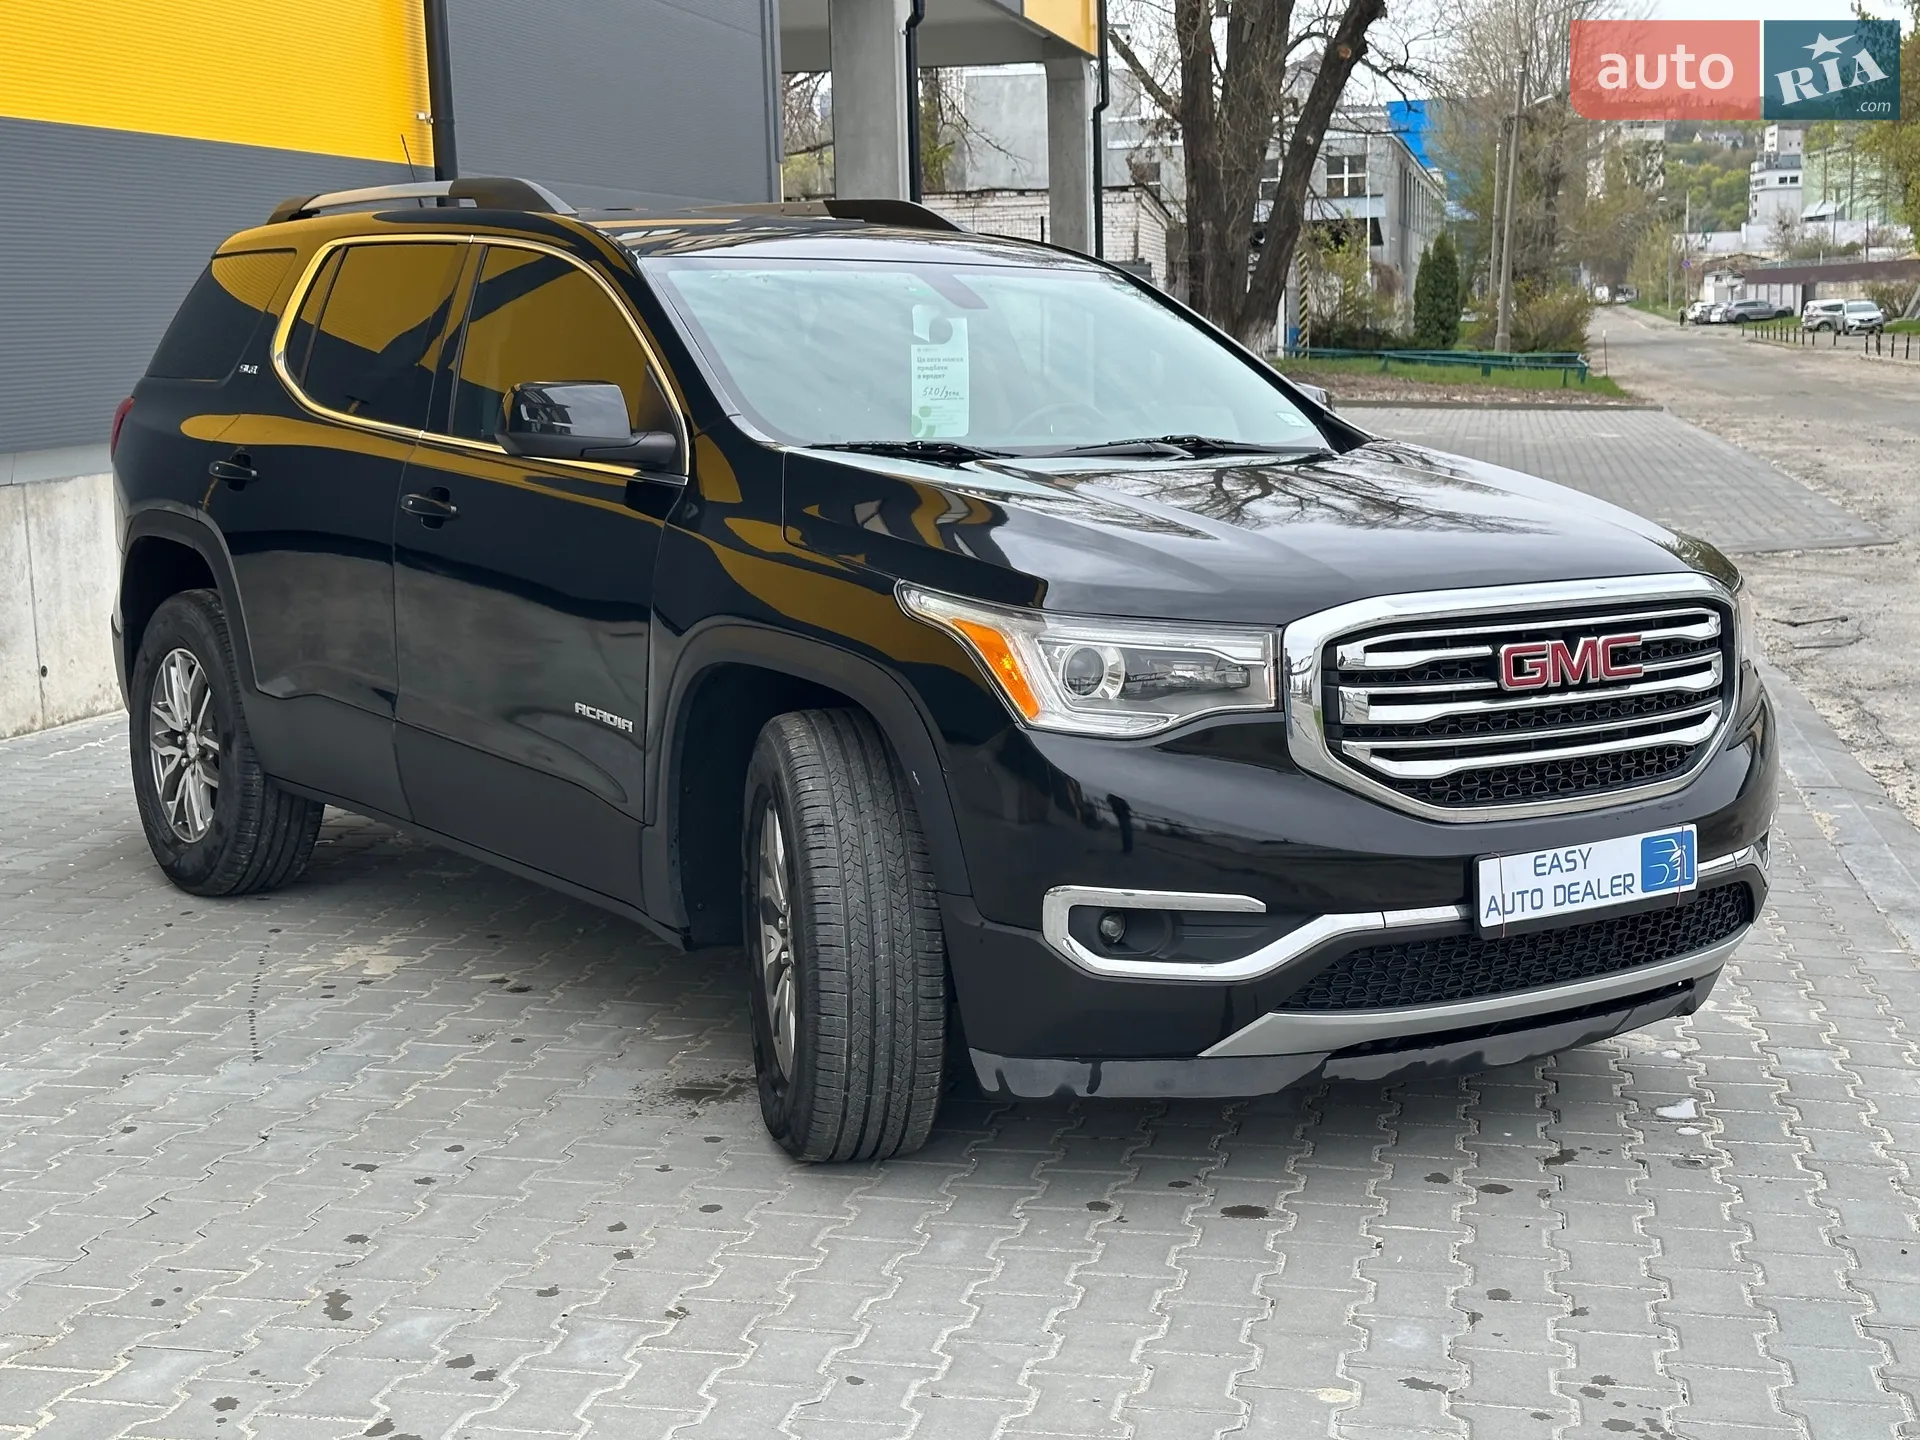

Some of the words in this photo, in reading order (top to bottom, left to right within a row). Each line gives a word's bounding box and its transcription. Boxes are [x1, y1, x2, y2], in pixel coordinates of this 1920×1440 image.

[1500, 633, 1645, 691] GMC
[574, 701, 633, 733] ACADIA
[1533, 847, 1593, 877] EASY
[1485, 887, 1544, 919] AUTO
[1553, 872, 1635, 907] DEALER
